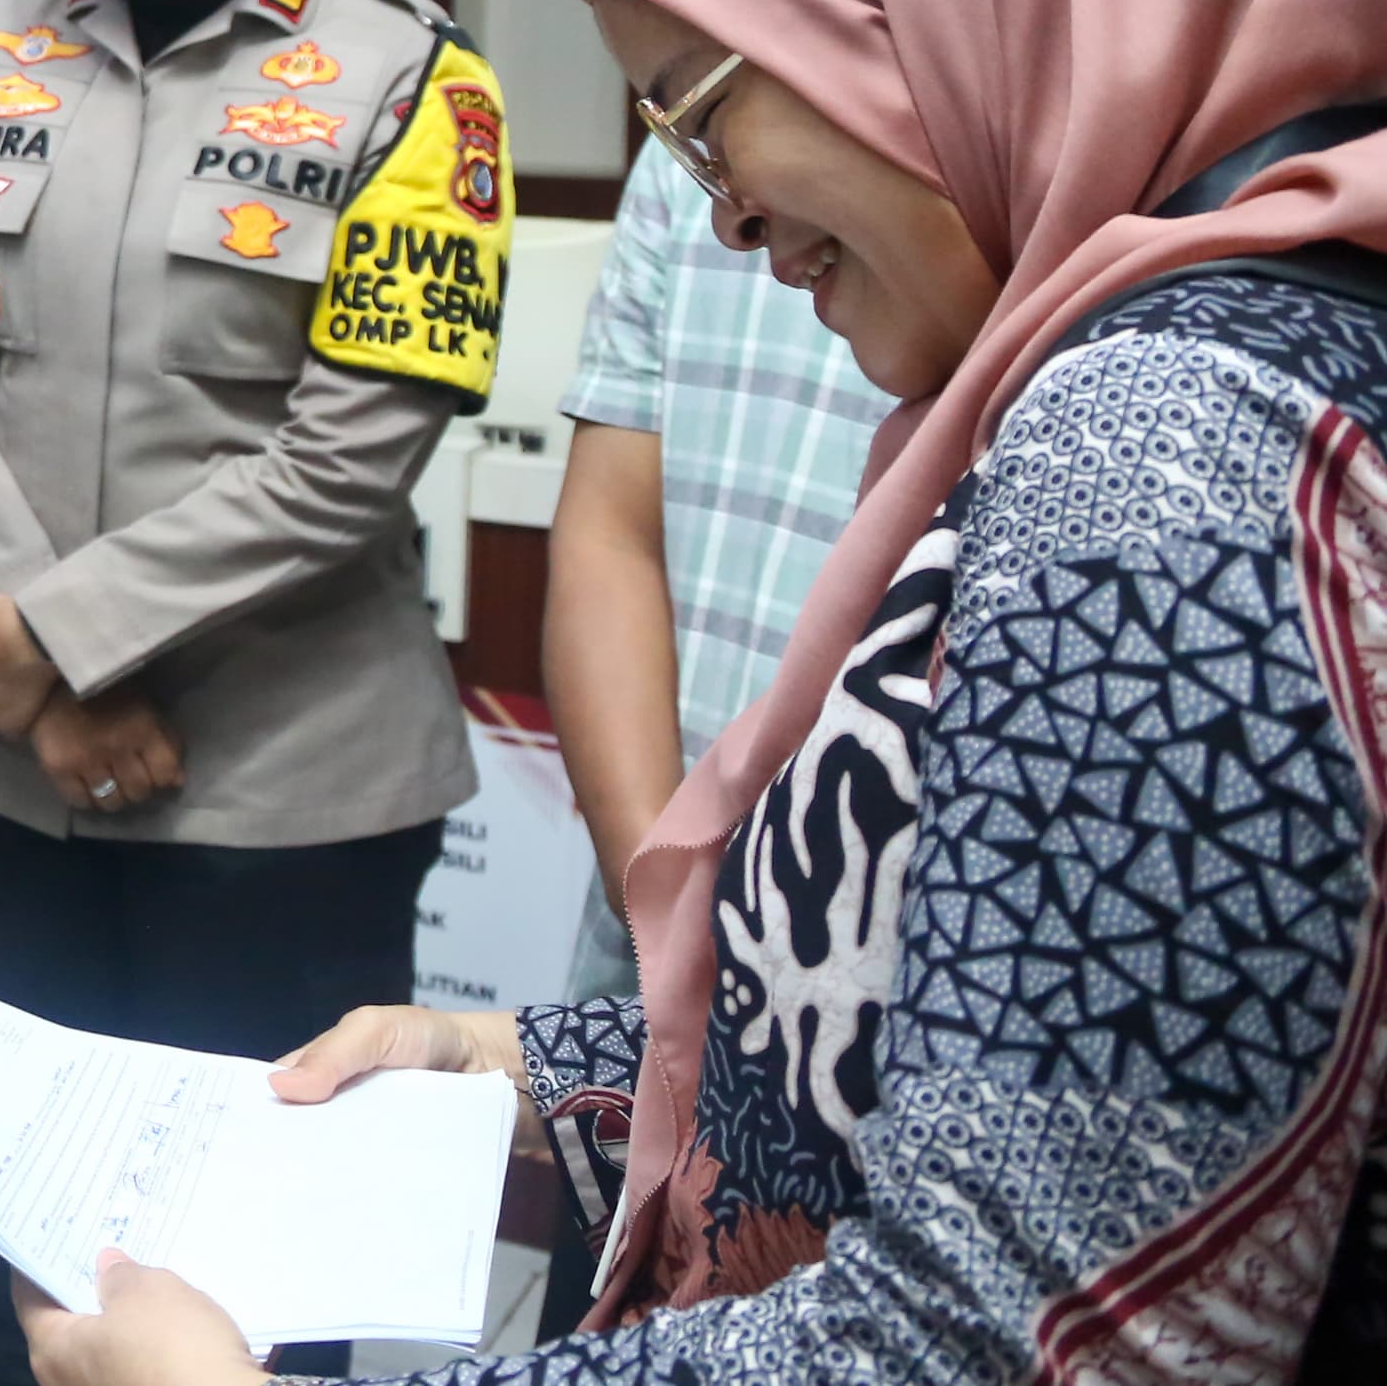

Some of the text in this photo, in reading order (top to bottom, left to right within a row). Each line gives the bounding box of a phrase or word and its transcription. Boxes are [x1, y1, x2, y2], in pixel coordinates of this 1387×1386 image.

[193, 146, 344, 202] POLRI
[331, 272, 405, 316] KEC.
[330, 313, 412, 345] OMP
